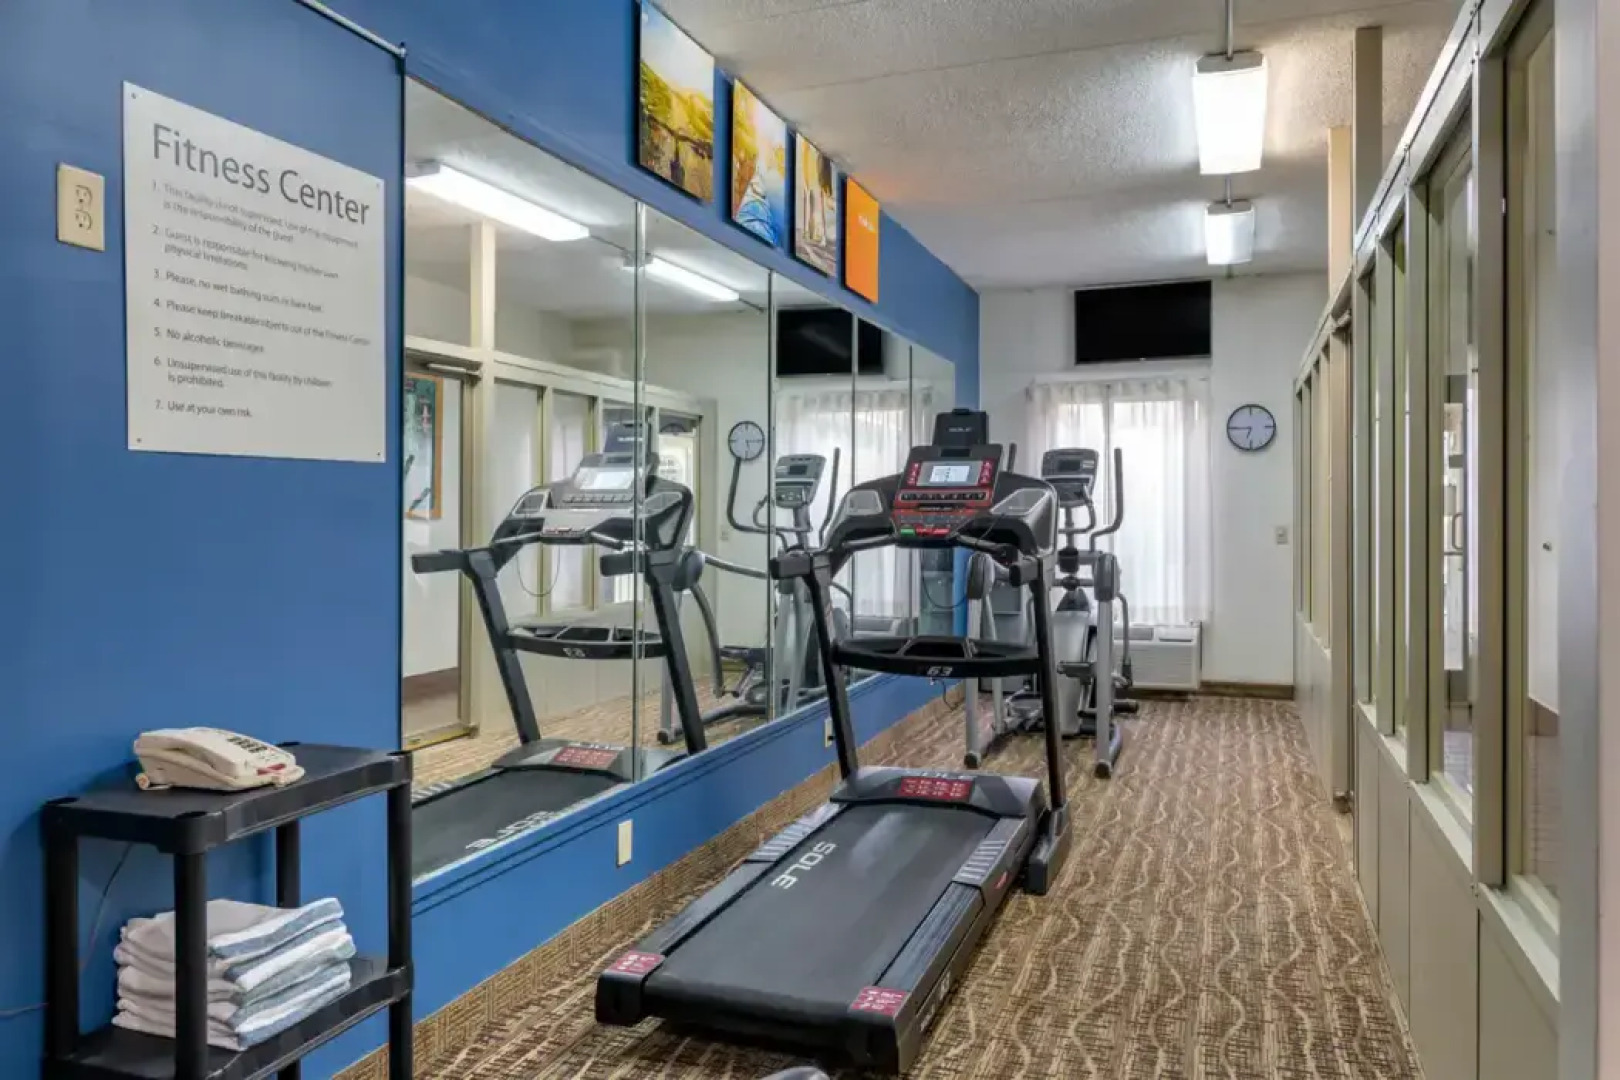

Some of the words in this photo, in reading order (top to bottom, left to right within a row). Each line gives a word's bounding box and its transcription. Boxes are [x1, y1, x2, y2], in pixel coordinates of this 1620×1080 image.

[153, 122, 270, 194] Fitness
[280, 169, 369, 225] Center
[198, 277, 210, 290] no
[212, 280, 227, 294] wet
[229, 283, 261, 301] bathing
[166, 299, 197, 315] Please
[196, 305, 218, 319] keep
[165, 327, 181, 341] No
[181, 330, 222, 347] alcoholic
[167, 356, 227, 376] Unsupervised
[227, 364, 242, 377] use
[243, 366, 252, 379] of
[167, 399, 184, 413] Use
[184, 401, 195, 414] at
[195, 402, 216, 416] your
[216, 404, 236, 417] own
[770, 840, 837, 890] SOLE
